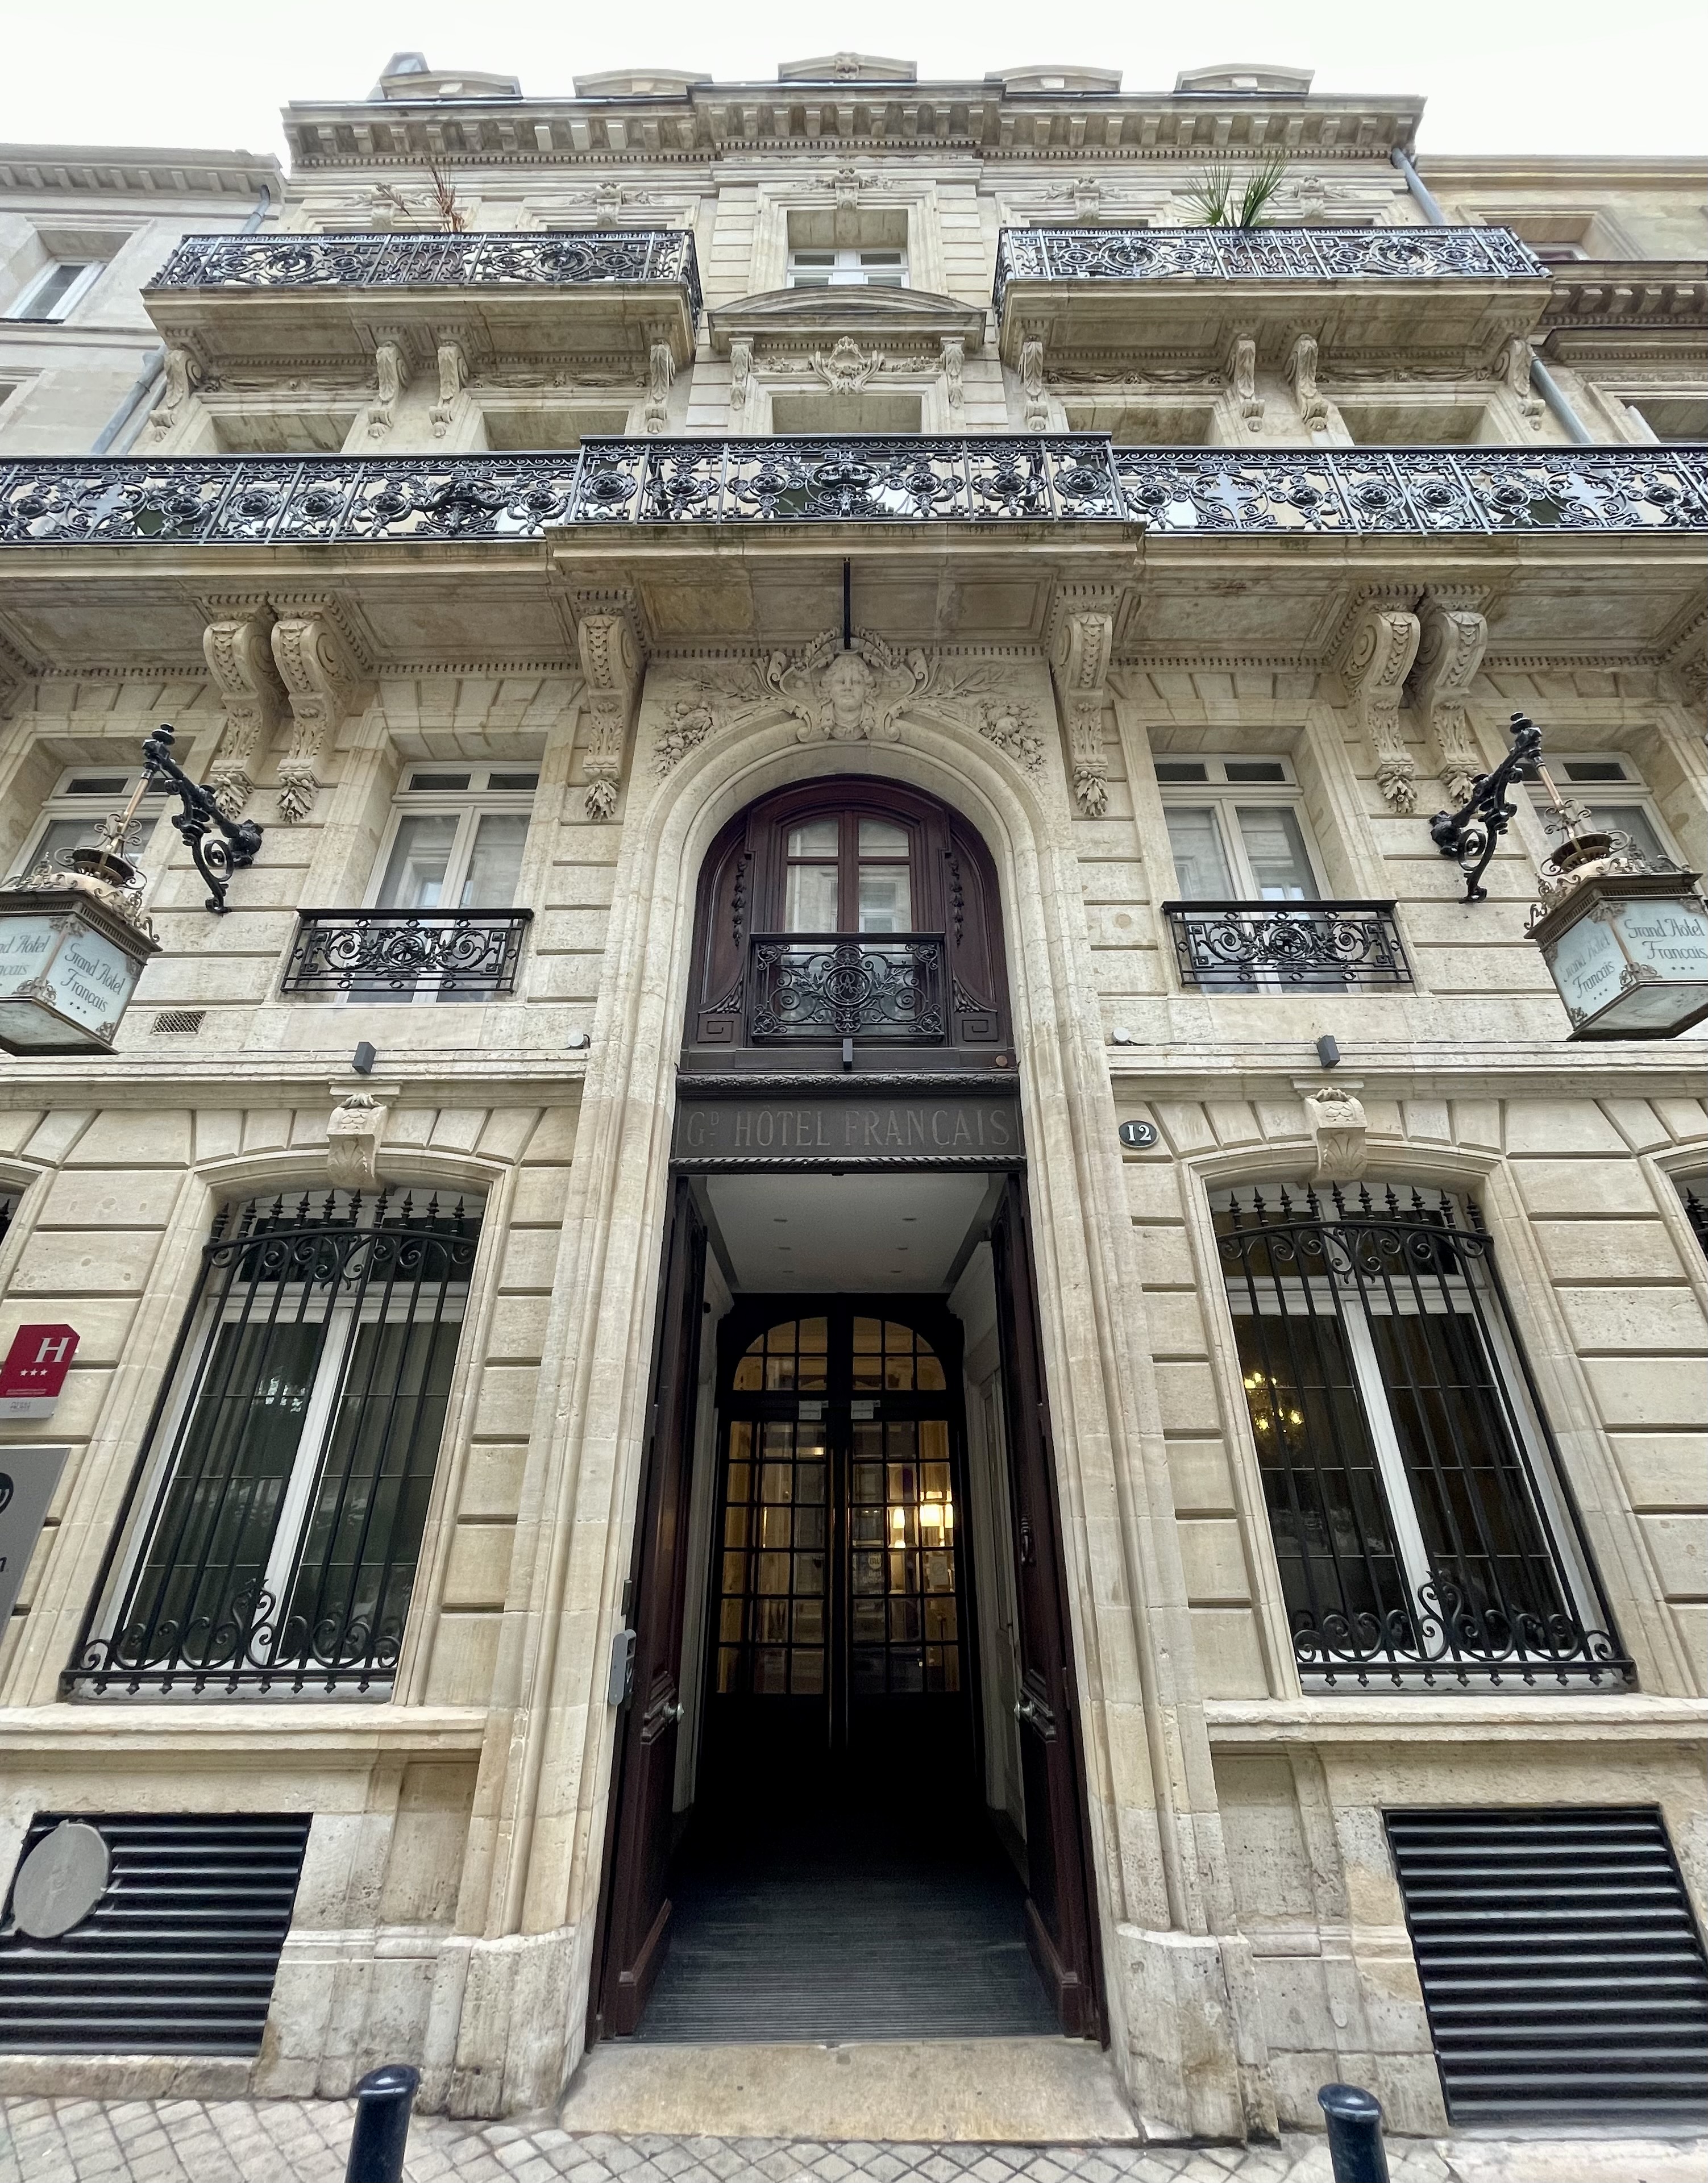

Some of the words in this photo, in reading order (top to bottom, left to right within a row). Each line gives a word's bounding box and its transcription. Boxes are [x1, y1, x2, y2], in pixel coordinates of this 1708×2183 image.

[1624, 918, 1668, 938] Grand
[65, 942, 100, 977] Grand
[1128, 1125, 1152, 1141] 12
[32, 1337, 73, 1363] H
